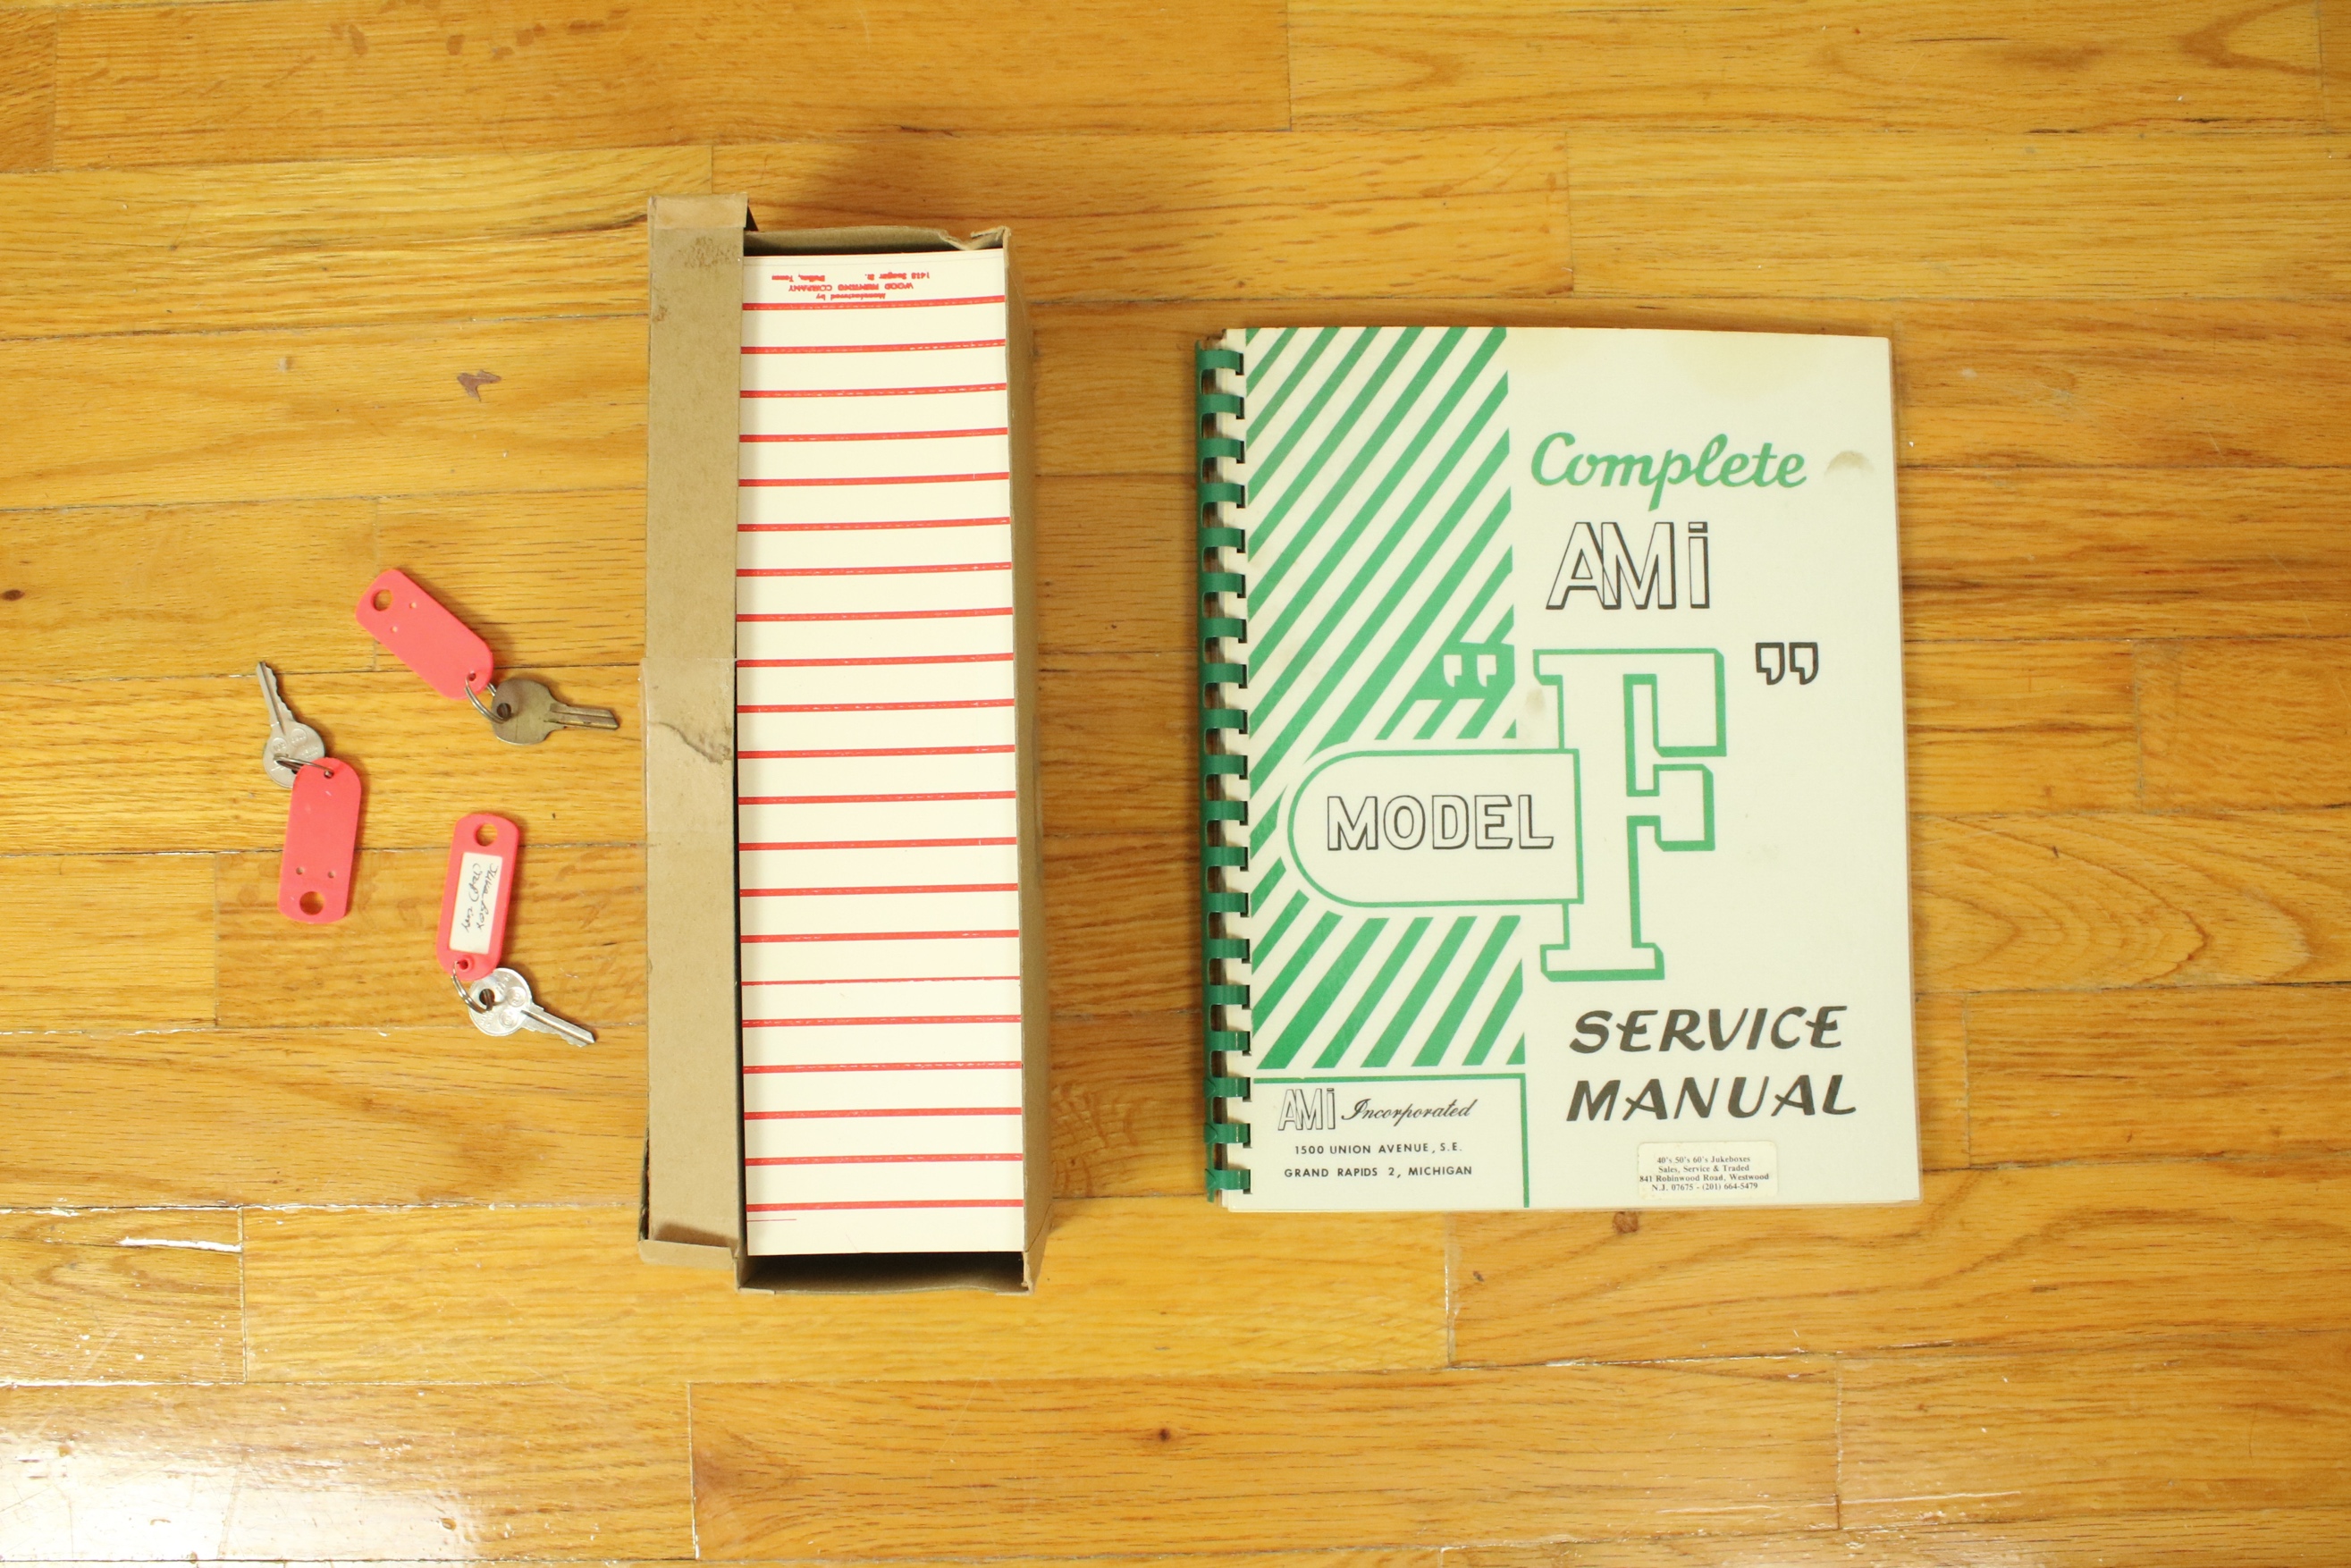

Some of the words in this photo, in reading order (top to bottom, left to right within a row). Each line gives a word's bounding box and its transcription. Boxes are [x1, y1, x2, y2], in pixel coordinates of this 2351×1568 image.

[884, 282, 914, 291] WOOD
[1530, 433, 1807, 511] Complete
[1327, 795, 1555, 851] MODEL
[1569, 1005, 1848, 1054] SERVICE
[1566, 1075, 1857, 1122] MANUAL
[1341, 1099, 1479, 1126] Incorporated
[1294, 1145, 1324, 1154] 1500
[1329, 1144, 1371, 1154] UNION
[1378, 1142, 1436, 1154] AVENUE,
[1440, 1142, 1462, 1151] S.E.
[1656, 1156, 1672, 1164] 40's
[1711, 1155, 1750, 1163] Jukeboxes
[1285, 1168, 1329, 1177] GRAND
[1337, 1168, 1378, 1176] RAPIDS
[1388, 1168, 1401, 1178] 2,
[1408, 1167, 1472, 1176] MICHIGAN
[1703, 1174, 1726, 1182] Road,
[1730, 1173, 1769, 1181] Westwood
[1702, 1183, 1722, 1191] (201)
[1723, 1182, 1758, 1190] 664-5479
